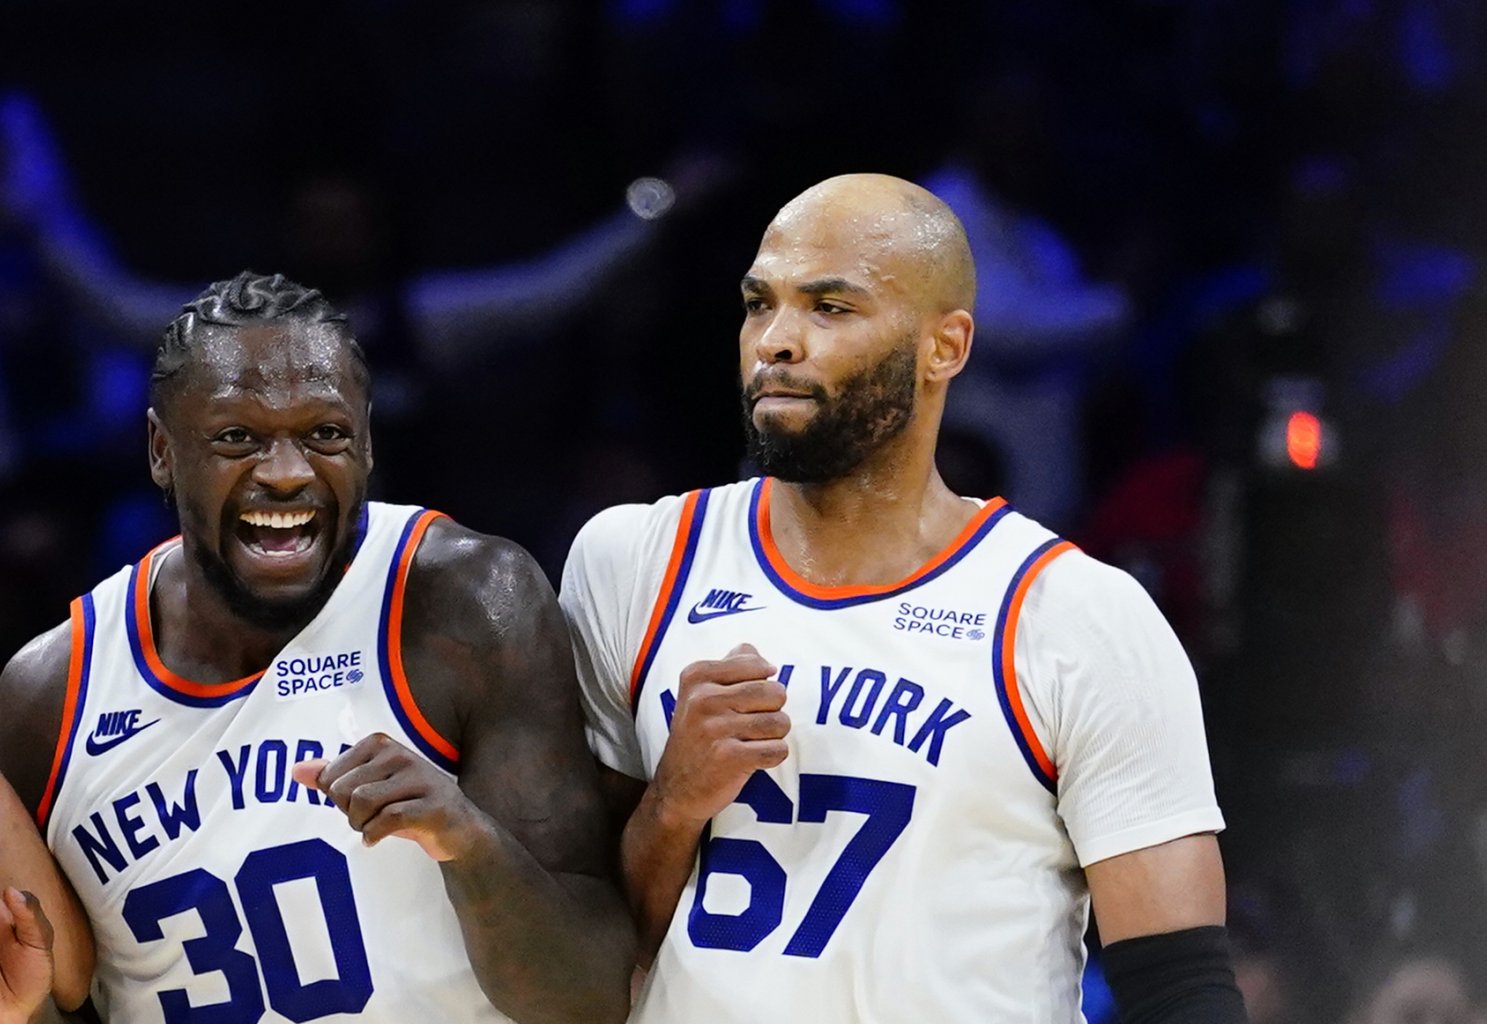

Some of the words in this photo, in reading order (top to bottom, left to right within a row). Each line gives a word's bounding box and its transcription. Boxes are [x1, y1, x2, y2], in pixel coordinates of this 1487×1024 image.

[699, 588, 752, 612] NIKE
[898, 602, 987, 626] SQUARE
[893, 617, 964, 639] SPACE
[276, 650, 361, 677] SQUARE
[277, 671, 344, 697] SPACE
[95, 709, 142, 738] NIKE
[815, 665, 972, 768] YORK
[72, 769, 202, 886] NEW
[687, 768, 917, 959] 67
